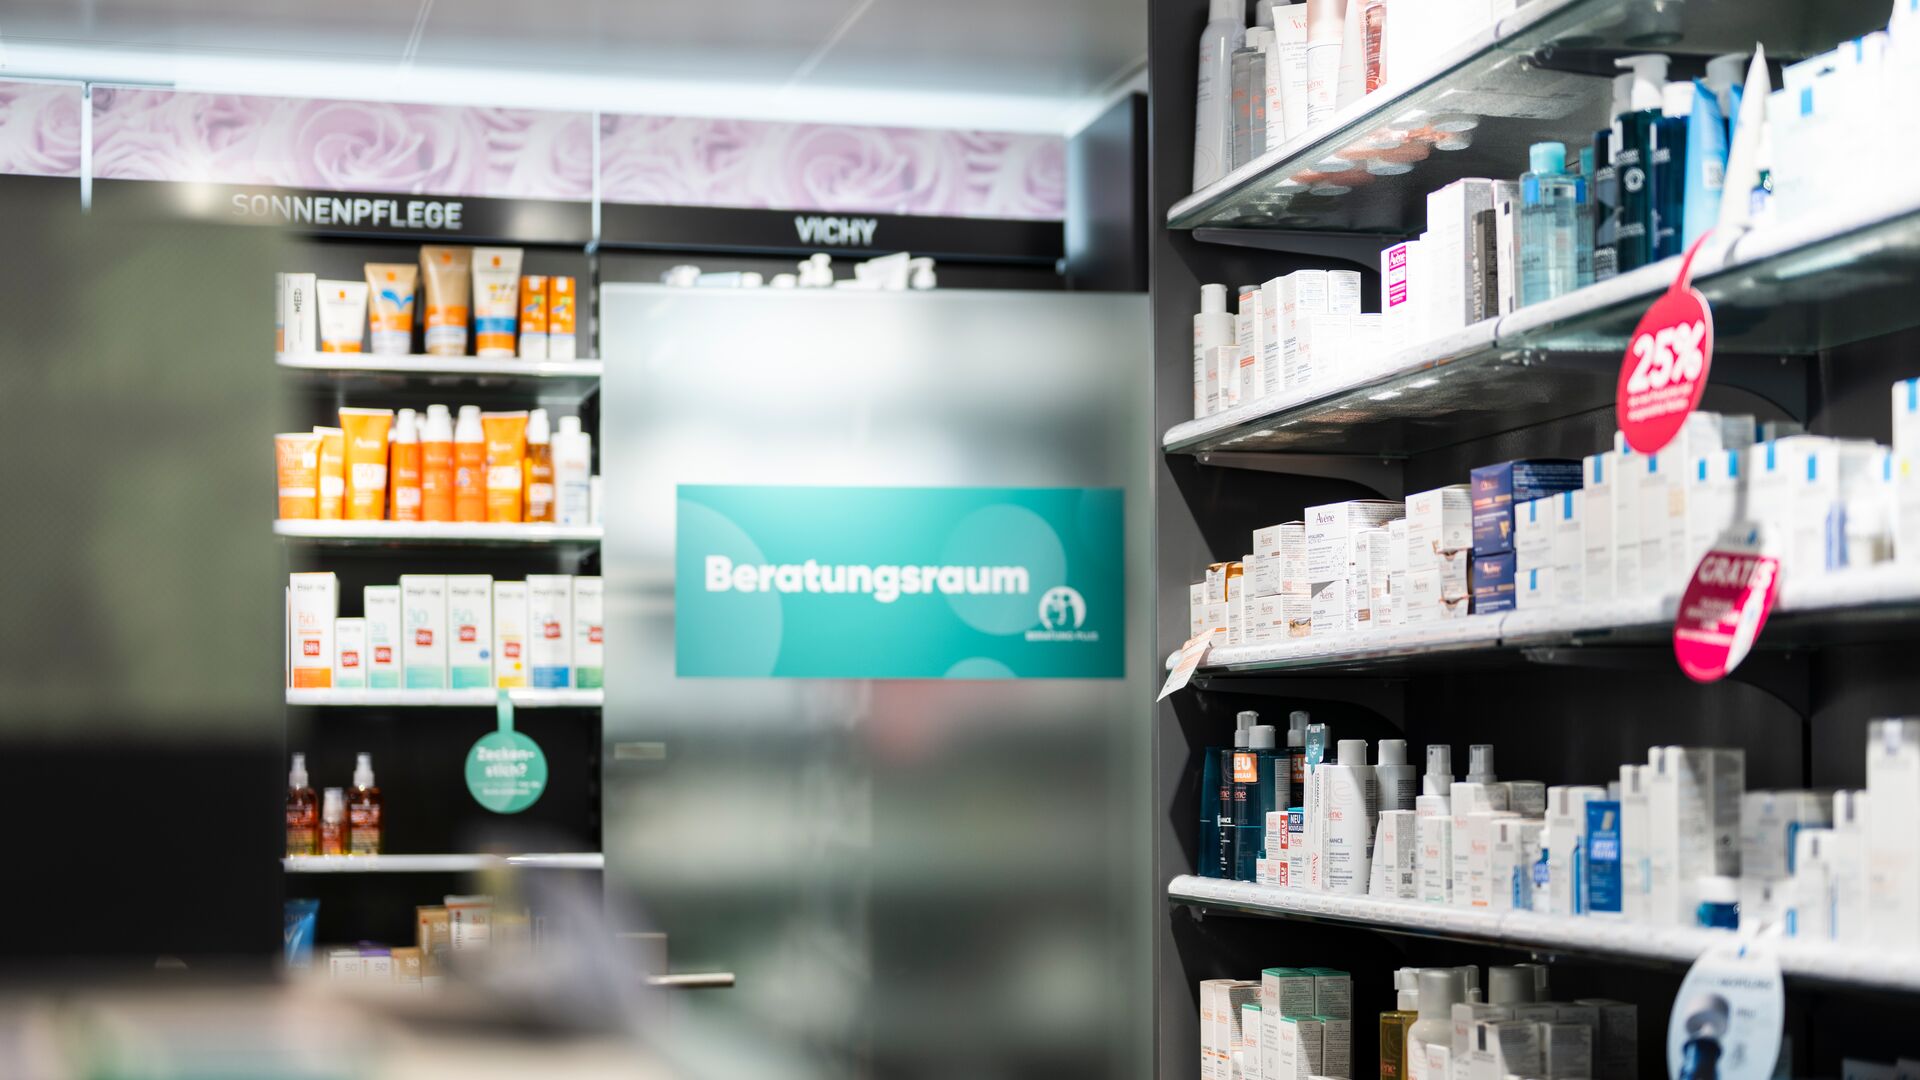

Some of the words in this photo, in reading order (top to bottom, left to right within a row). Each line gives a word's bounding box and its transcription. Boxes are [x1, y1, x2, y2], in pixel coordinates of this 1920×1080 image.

[231, 193, 463, 230] SONNENPFLEGE
[794, 215, 878, 247] VICHY
[1627, 319, 1705, 394] 25%
[705, 554, 1029, 603] Beratungsraum
[1698, 555, 1776, 592] GRATIS
[477, 746, 535, 762] Zecken-
[485, 762, 528, 778] stich?
[1290, 814, 1301, 824] NEU
